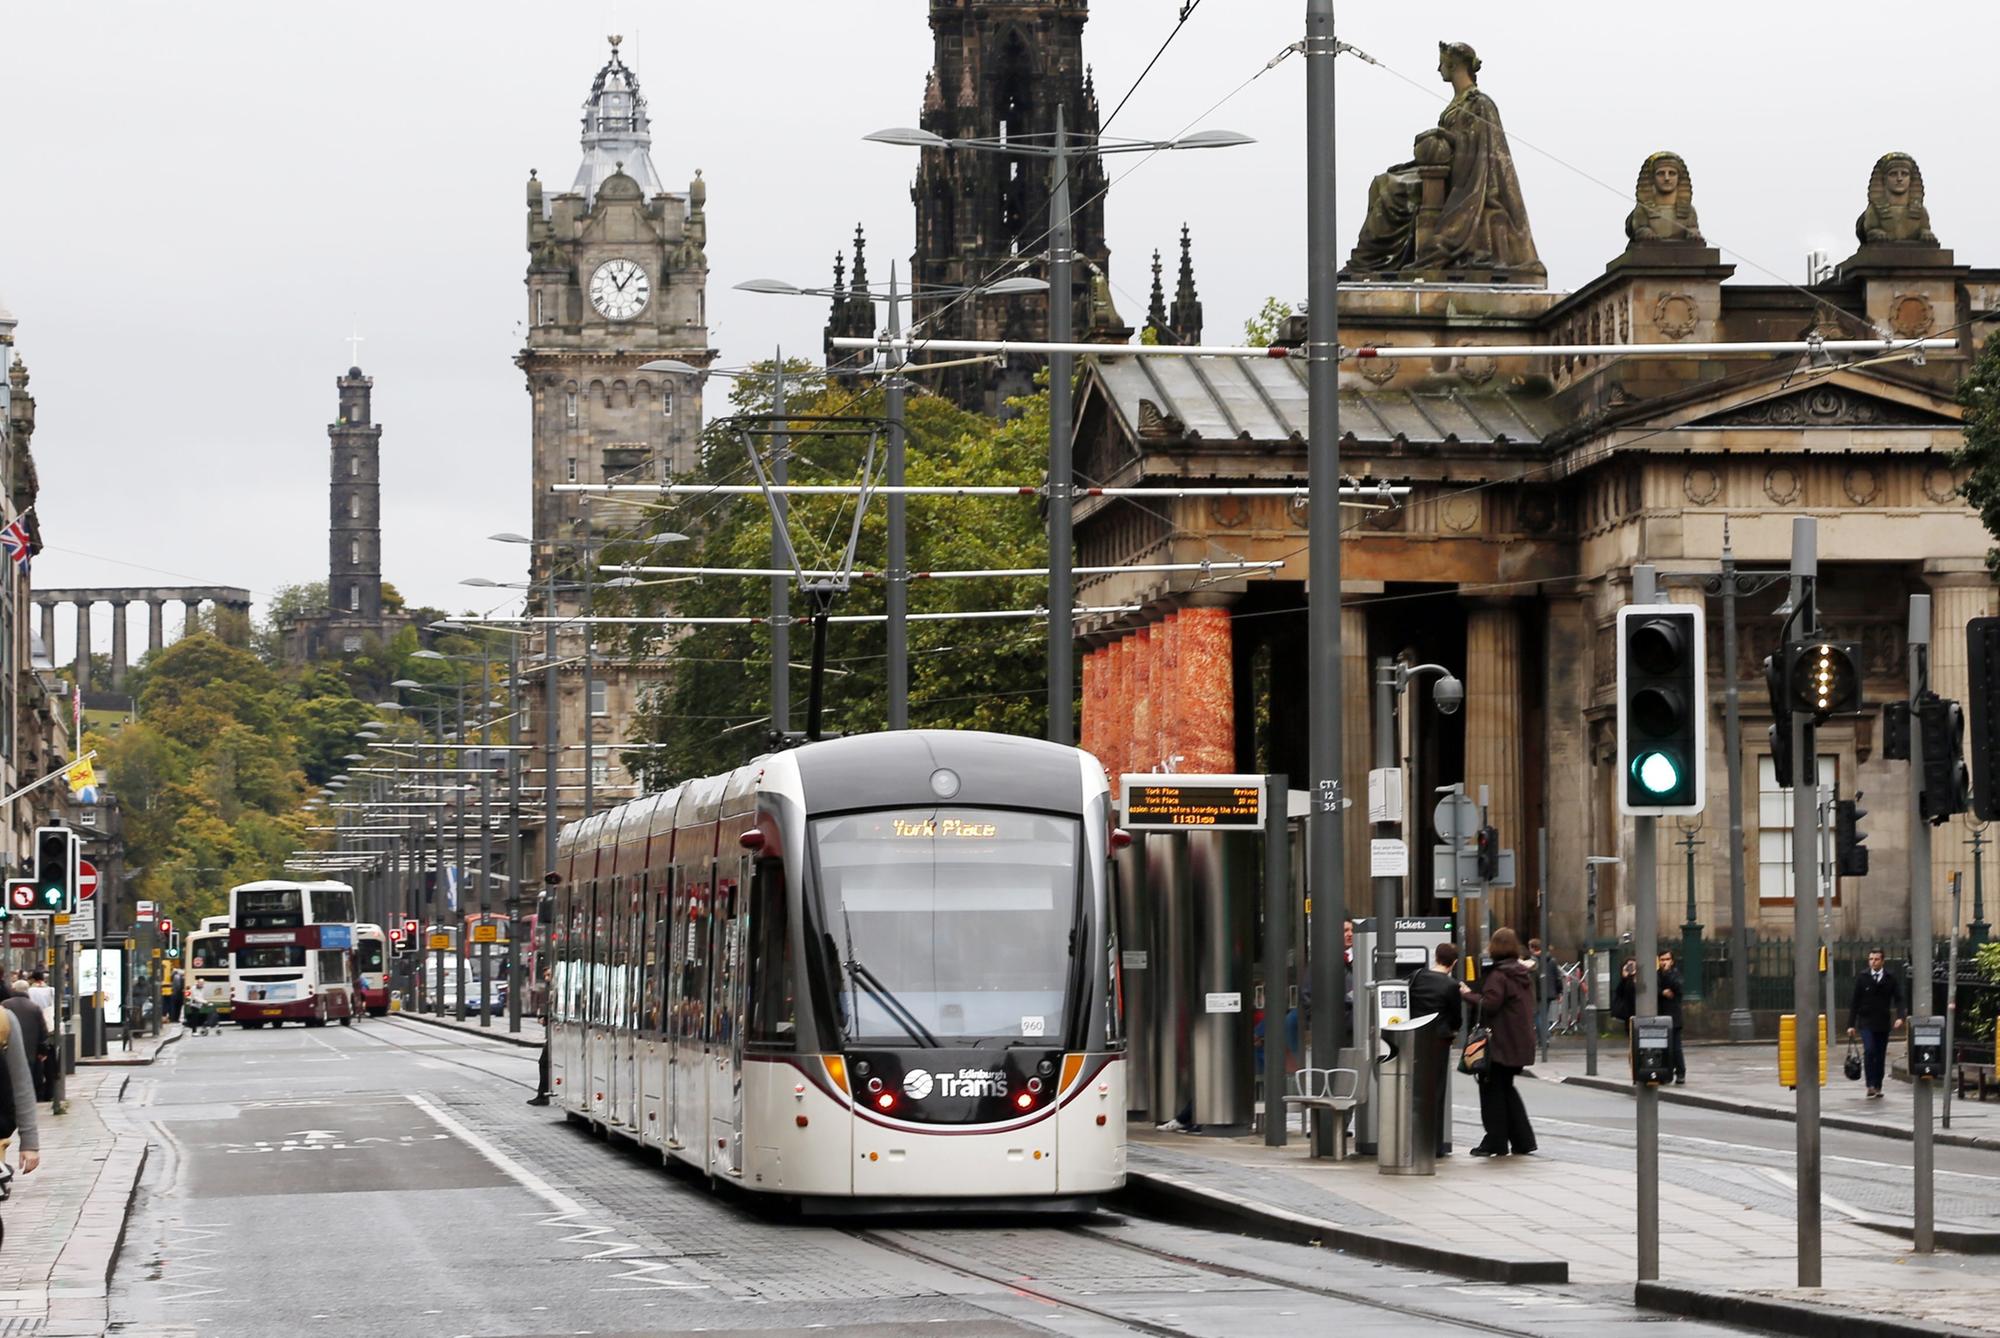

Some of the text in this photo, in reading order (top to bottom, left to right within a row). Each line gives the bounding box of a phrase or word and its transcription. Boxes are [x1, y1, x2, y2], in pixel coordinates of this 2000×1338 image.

[1320, 780, 1338, 789] CTY
[1145, 787, 1179, 796] York Place
[1324, 791, 1334, 800] 12
[1145, 796, 1179, 805] York Place
[1324, 802, 1336, 811] 35
[893, 819, 996, 836] York Place
[1023, 1021, 1042, 1031] 960
[959, 1068, 1006, 1080] Edinburgh
[935, 1073, 1008, 1097] Trams
